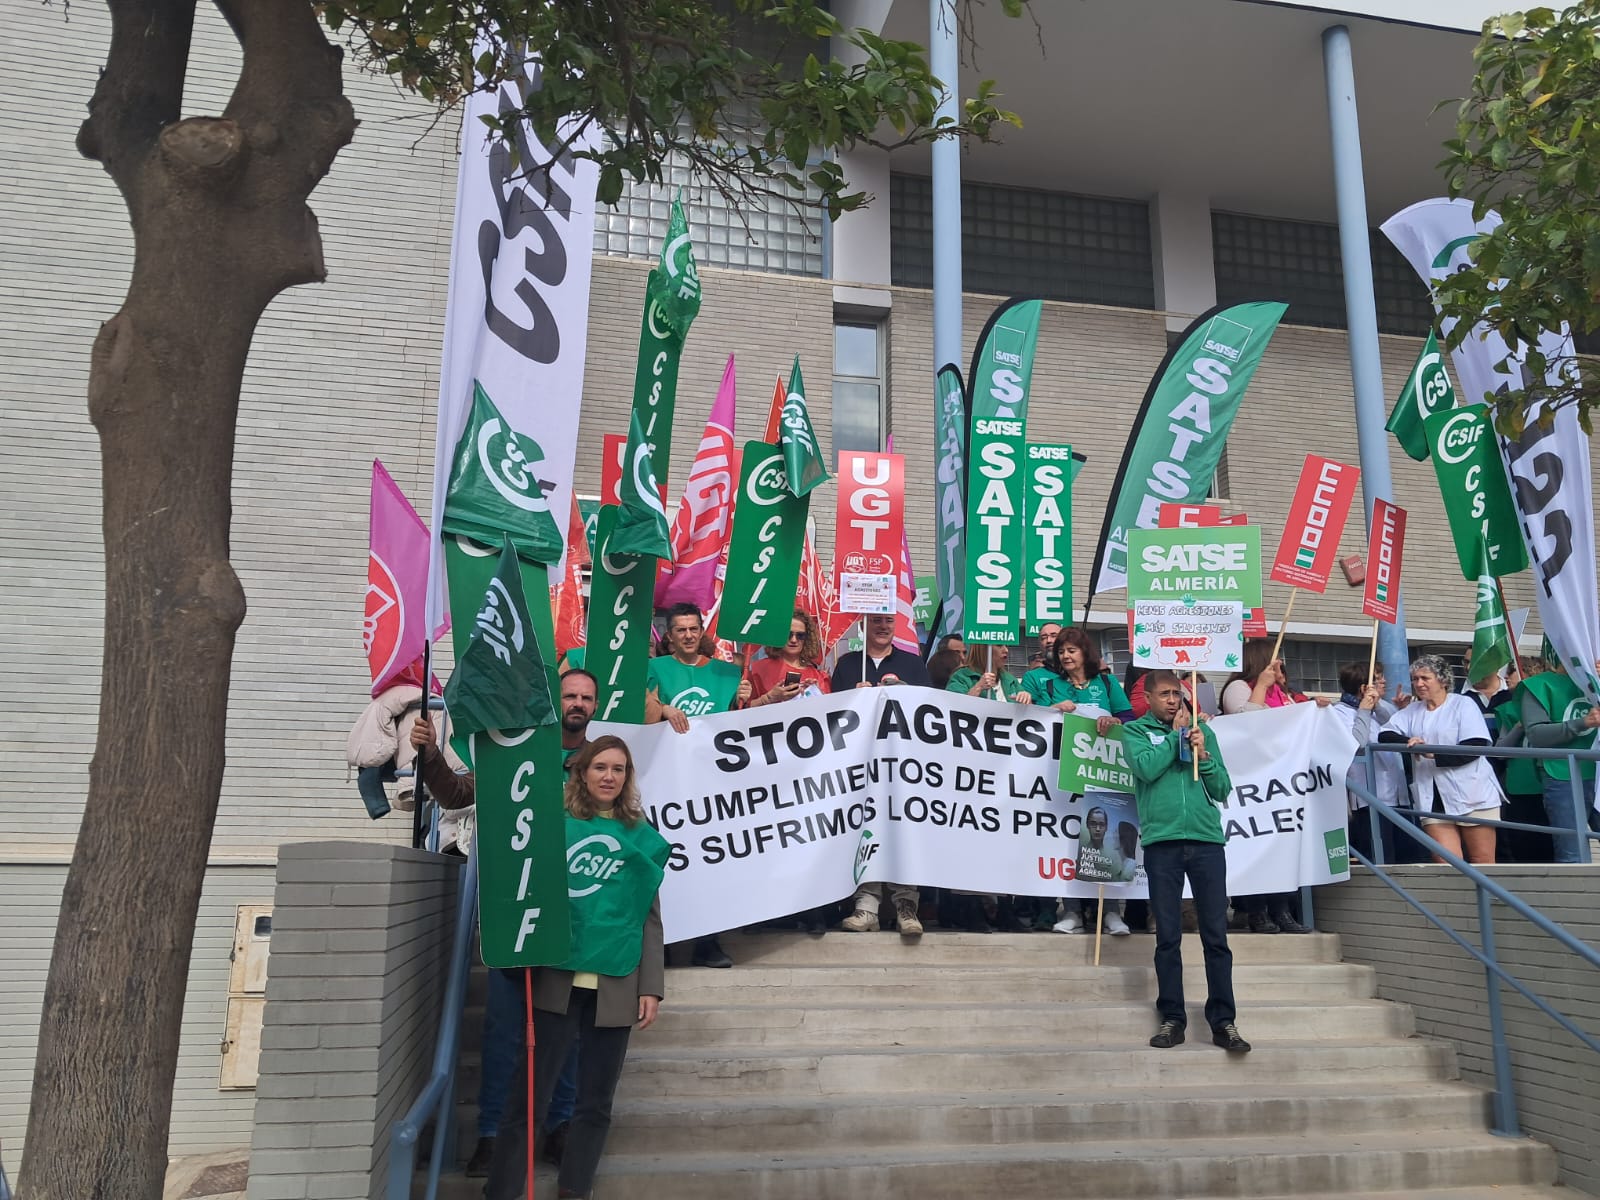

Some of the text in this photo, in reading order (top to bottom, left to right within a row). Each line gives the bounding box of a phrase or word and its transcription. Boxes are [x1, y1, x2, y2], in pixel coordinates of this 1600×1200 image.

[995, 350, 1020, 365] SATSE
[1204, 339, 1239, 359] SATSE
[975, 420, 1022, 437] SATSE
[1447, 424, 1485, 448] CSIF
[1029, 446, 1068, 460] SATSE
[850, 457, 890, 551] UGT
[1300, 462, 1342, 549] CCOO
[975, 442, 1016, 625] SATSE
[1032, 465, 1064, 620] SATSE
[1376, 505, 1397, 584] CCOO
[1141, 543, 1248, 573] SATSE
[740, 515, 782, 635] CSIF
[1150, 574, 1239, 591] ALMERÍA
[968, 630, 1015, 642] ALMERÍA
[603, 585, 634, 721] CSIF
[714, 699, 1063, 773] STOP AGRESI
[1076, 764, 1135, 788] ALMERÍ
[643, 758, 944, 833] NCUMPLIMIENTOS
[955, 766, 996, 796] DE
[1009, 773, 1052, 801] LA
[668, 842, 690, 872] S
[701, 797, 877, 865] SUFRIMOS
[889, 796, 1000, 832] LOS/AS
[510, 760, 541, 954] CSIF
[1081, 846, 1101, 855] NADA
[569, 852, 624, 880] CSIF
[1038, 857, 1076, 880] UG
